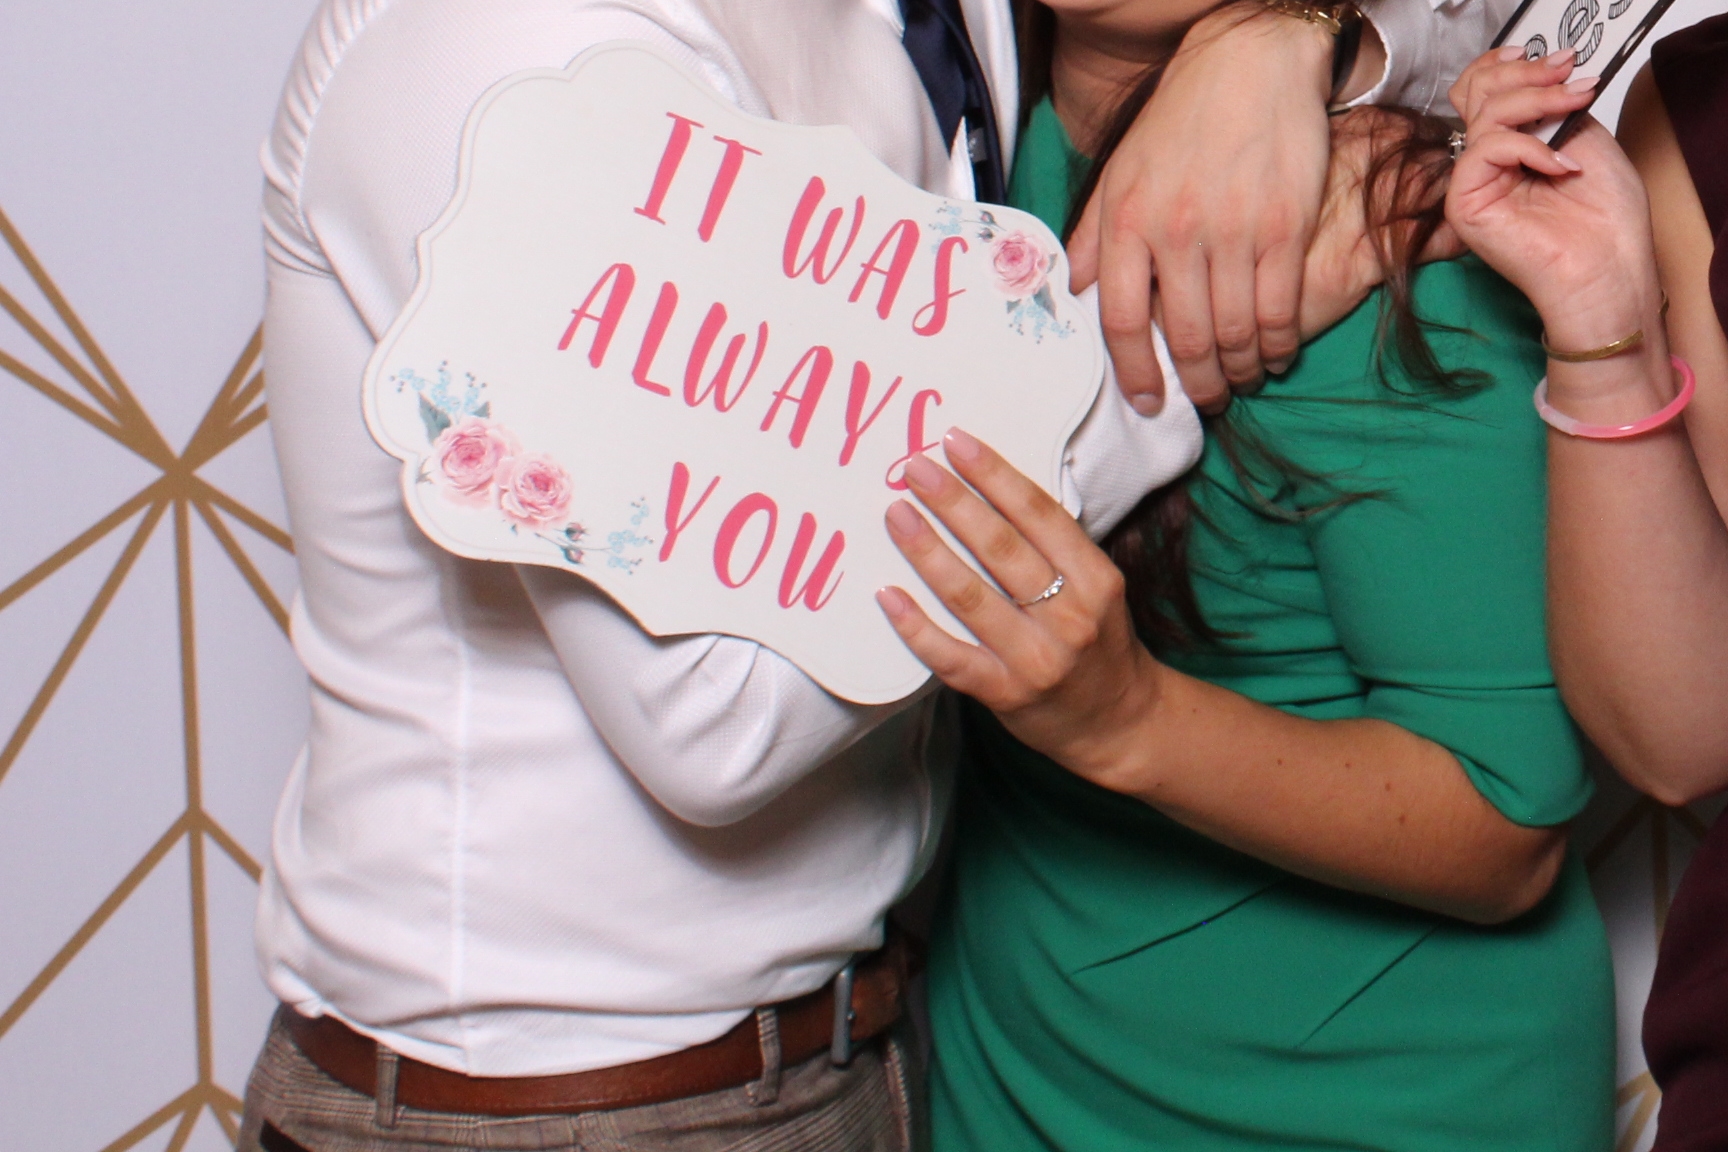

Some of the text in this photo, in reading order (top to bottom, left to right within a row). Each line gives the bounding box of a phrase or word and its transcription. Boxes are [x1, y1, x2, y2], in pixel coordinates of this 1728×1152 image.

[634, 111, 967, 336] IT WAS
[557, 262, 943, 491] ALWAYS
[659, 461, 845, 611] YOU
